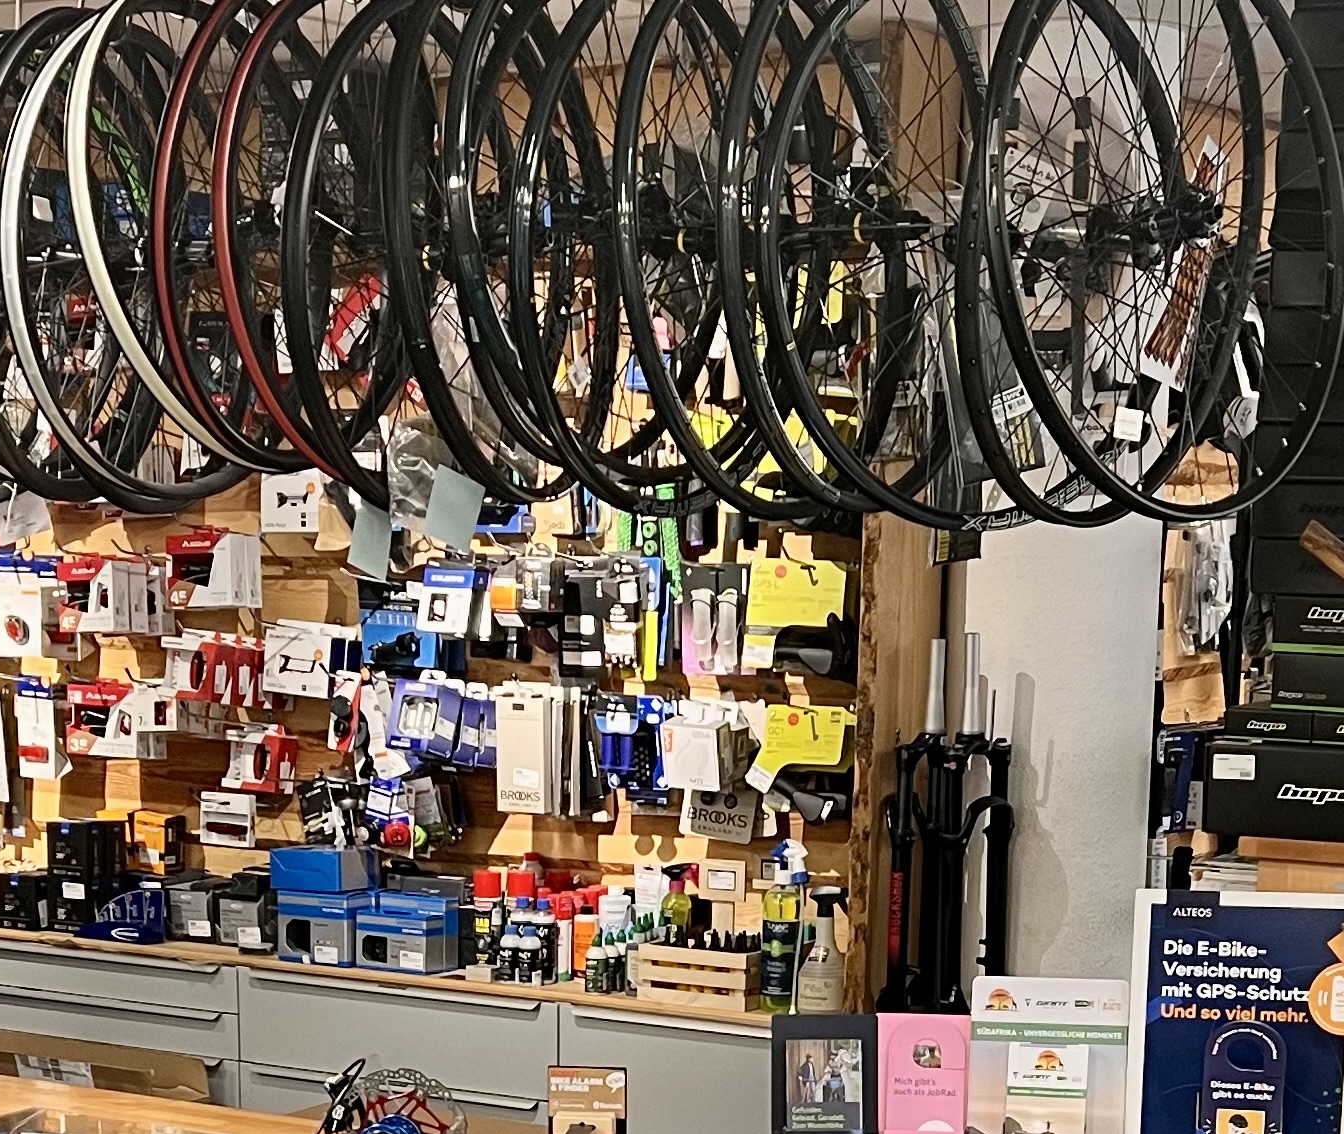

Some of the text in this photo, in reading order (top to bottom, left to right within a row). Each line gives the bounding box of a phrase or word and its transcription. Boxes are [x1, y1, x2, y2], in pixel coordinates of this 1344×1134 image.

[1247, 720, 1287, 732] hope
[501, 789, 541, 802] BROOKS
[687, 806, 749, 829] BROOKS
[1172, 907, 1213, 918] ALTEOS
[1163, 939, 1267, 957] Die E-Bike-
[1162, 960, 1283, 984] Versicherung
[1161, 982, 1311, 1002] mit GPS-Schutz
[1160, 1003, 1310, 1024] Und so viel mehr.
[976, 1027, 1018, 1037] SÜDAFRIKA
[1023, 1028, 1086, 1039] UNVERGESSLICHE
[1086, 1031, 1123, 1040] MOMENTE
[572, 1077, 604, 1086] ALARM
[894, 1077, 937, 1087] Mich gibt's
[893, 1088, 958, 1098] auch als JobRad.
[1212, 1091, 1232, 1100] gibt
[1233, 1092, 1245, 1100] es
